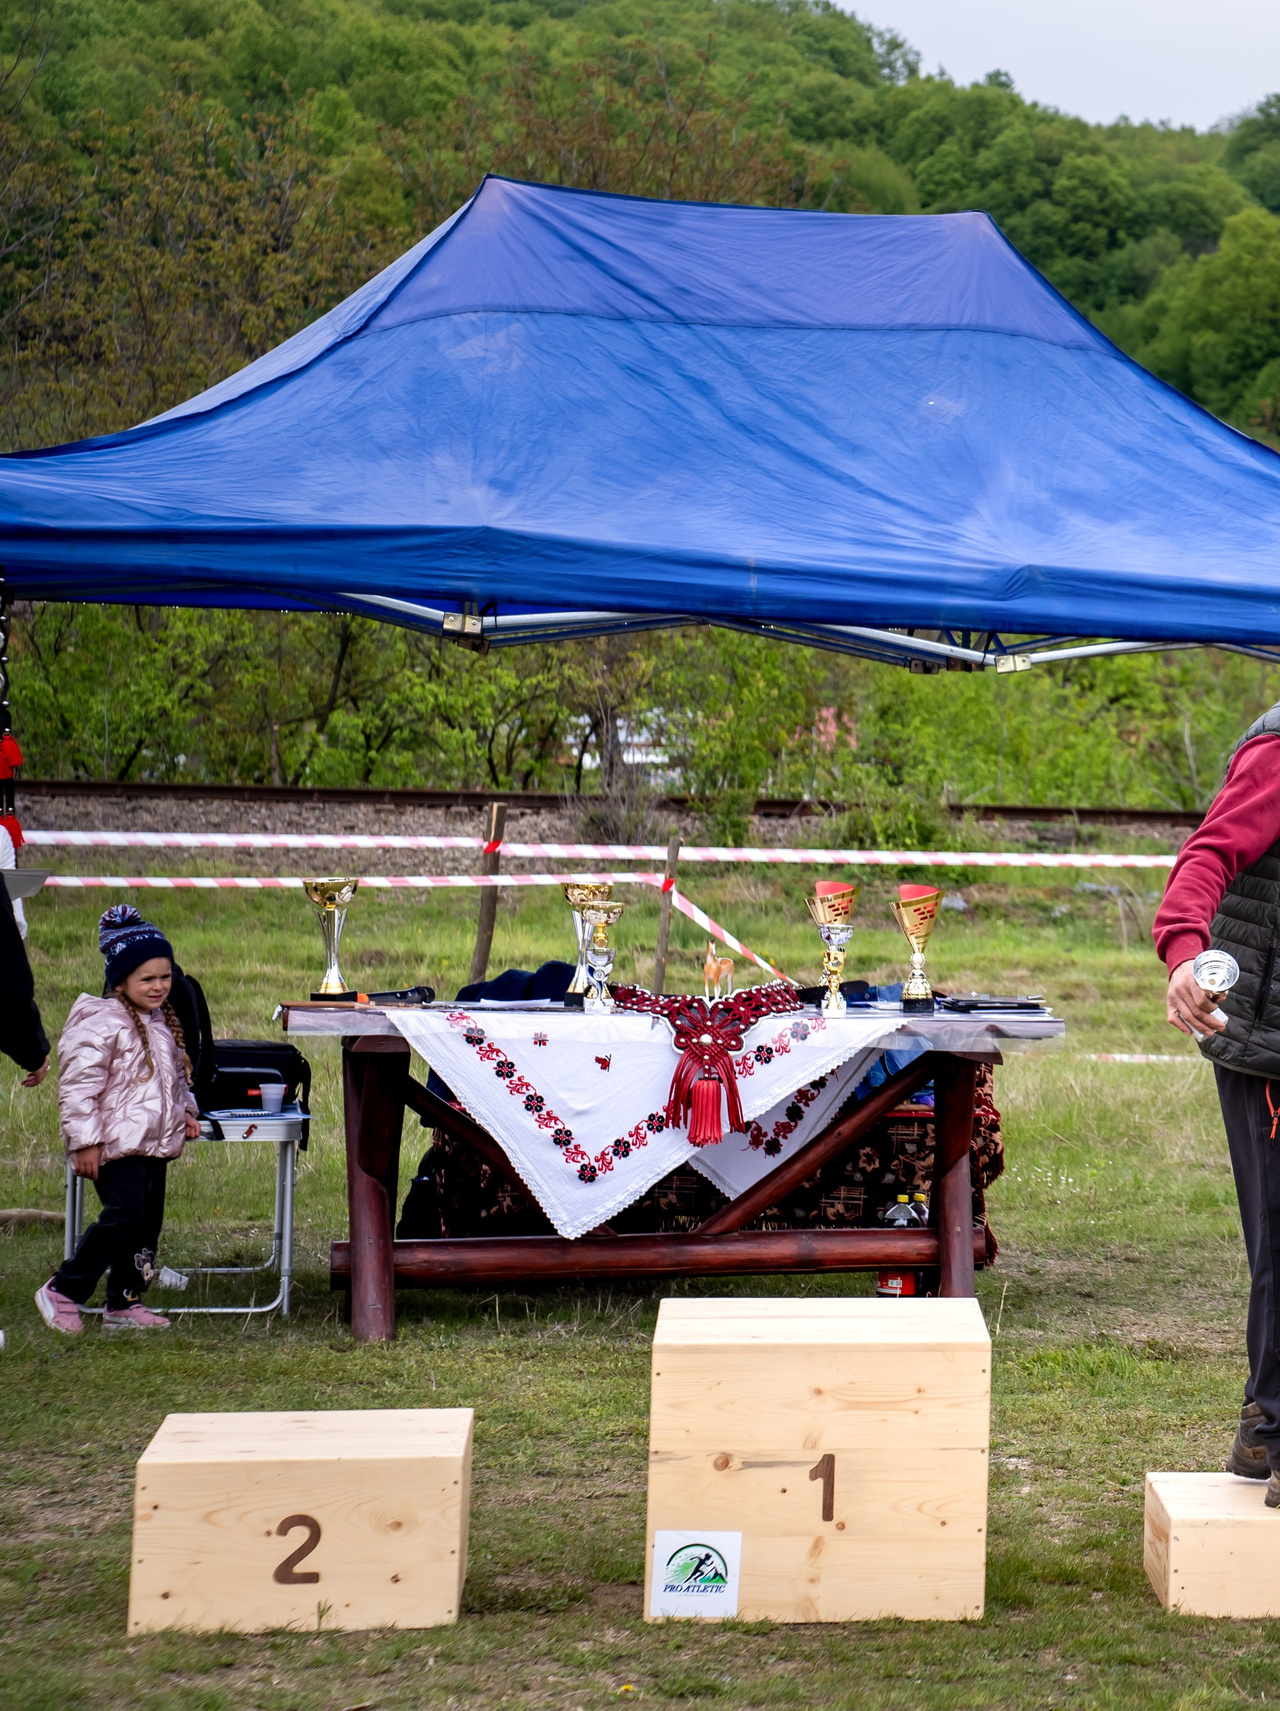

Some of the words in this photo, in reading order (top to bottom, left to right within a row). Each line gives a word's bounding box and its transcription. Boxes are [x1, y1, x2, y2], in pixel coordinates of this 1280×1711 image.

[808, 1453, 835, 1522] 1
[272, 1514, 322, 1585] 2
[663, 1584, 683, 1593] PRO
[682, 1584, 726, 1593] ATLETIC
